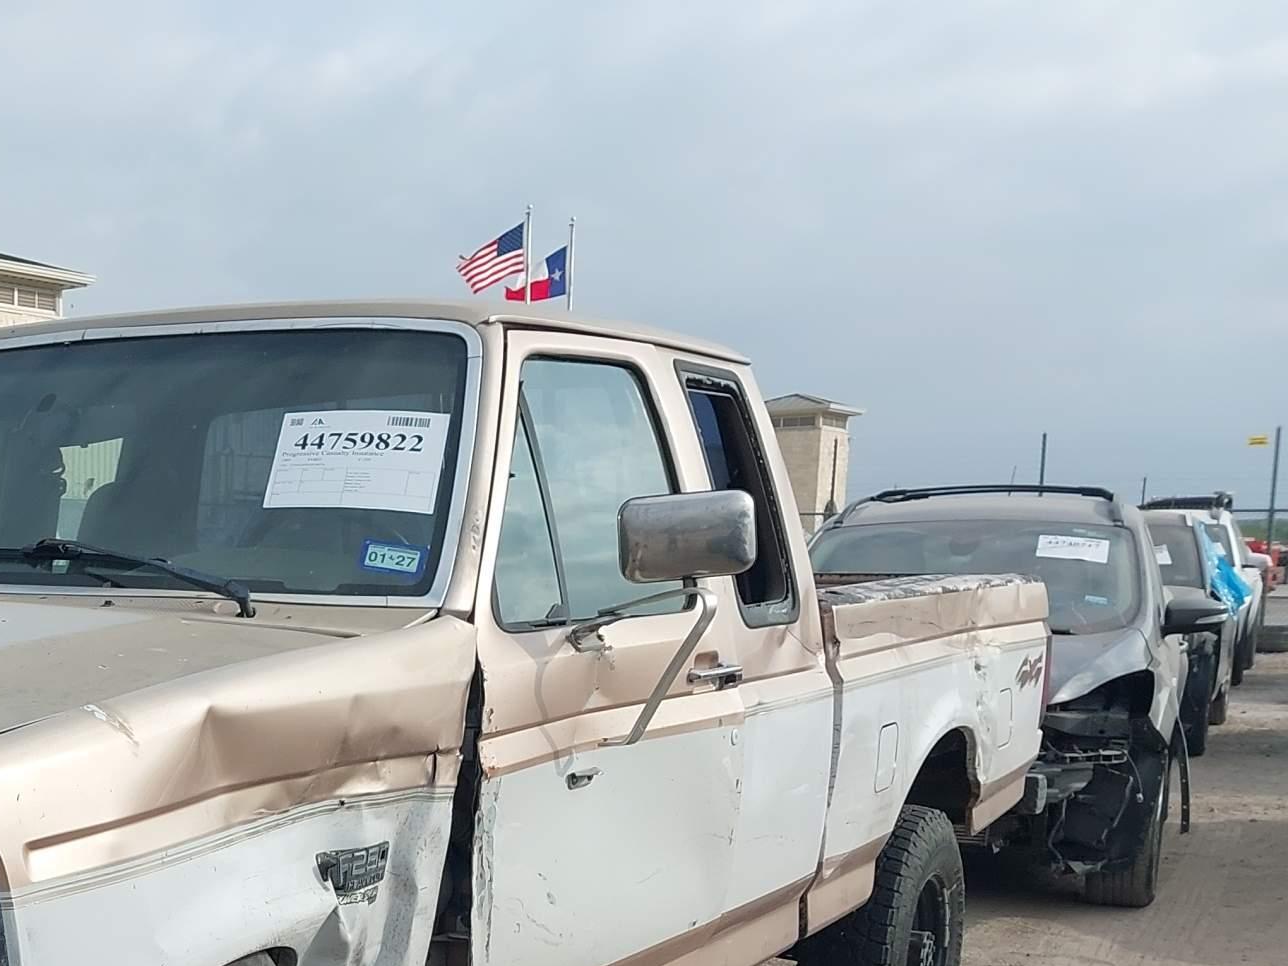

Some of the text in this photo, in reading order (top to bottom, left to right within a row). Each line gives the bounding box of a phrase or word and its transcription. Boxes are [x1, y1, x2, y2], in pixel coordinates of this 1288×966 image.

[294, 432, 424, 452] 44759822
[368, 551, 416, 567] 01 27
